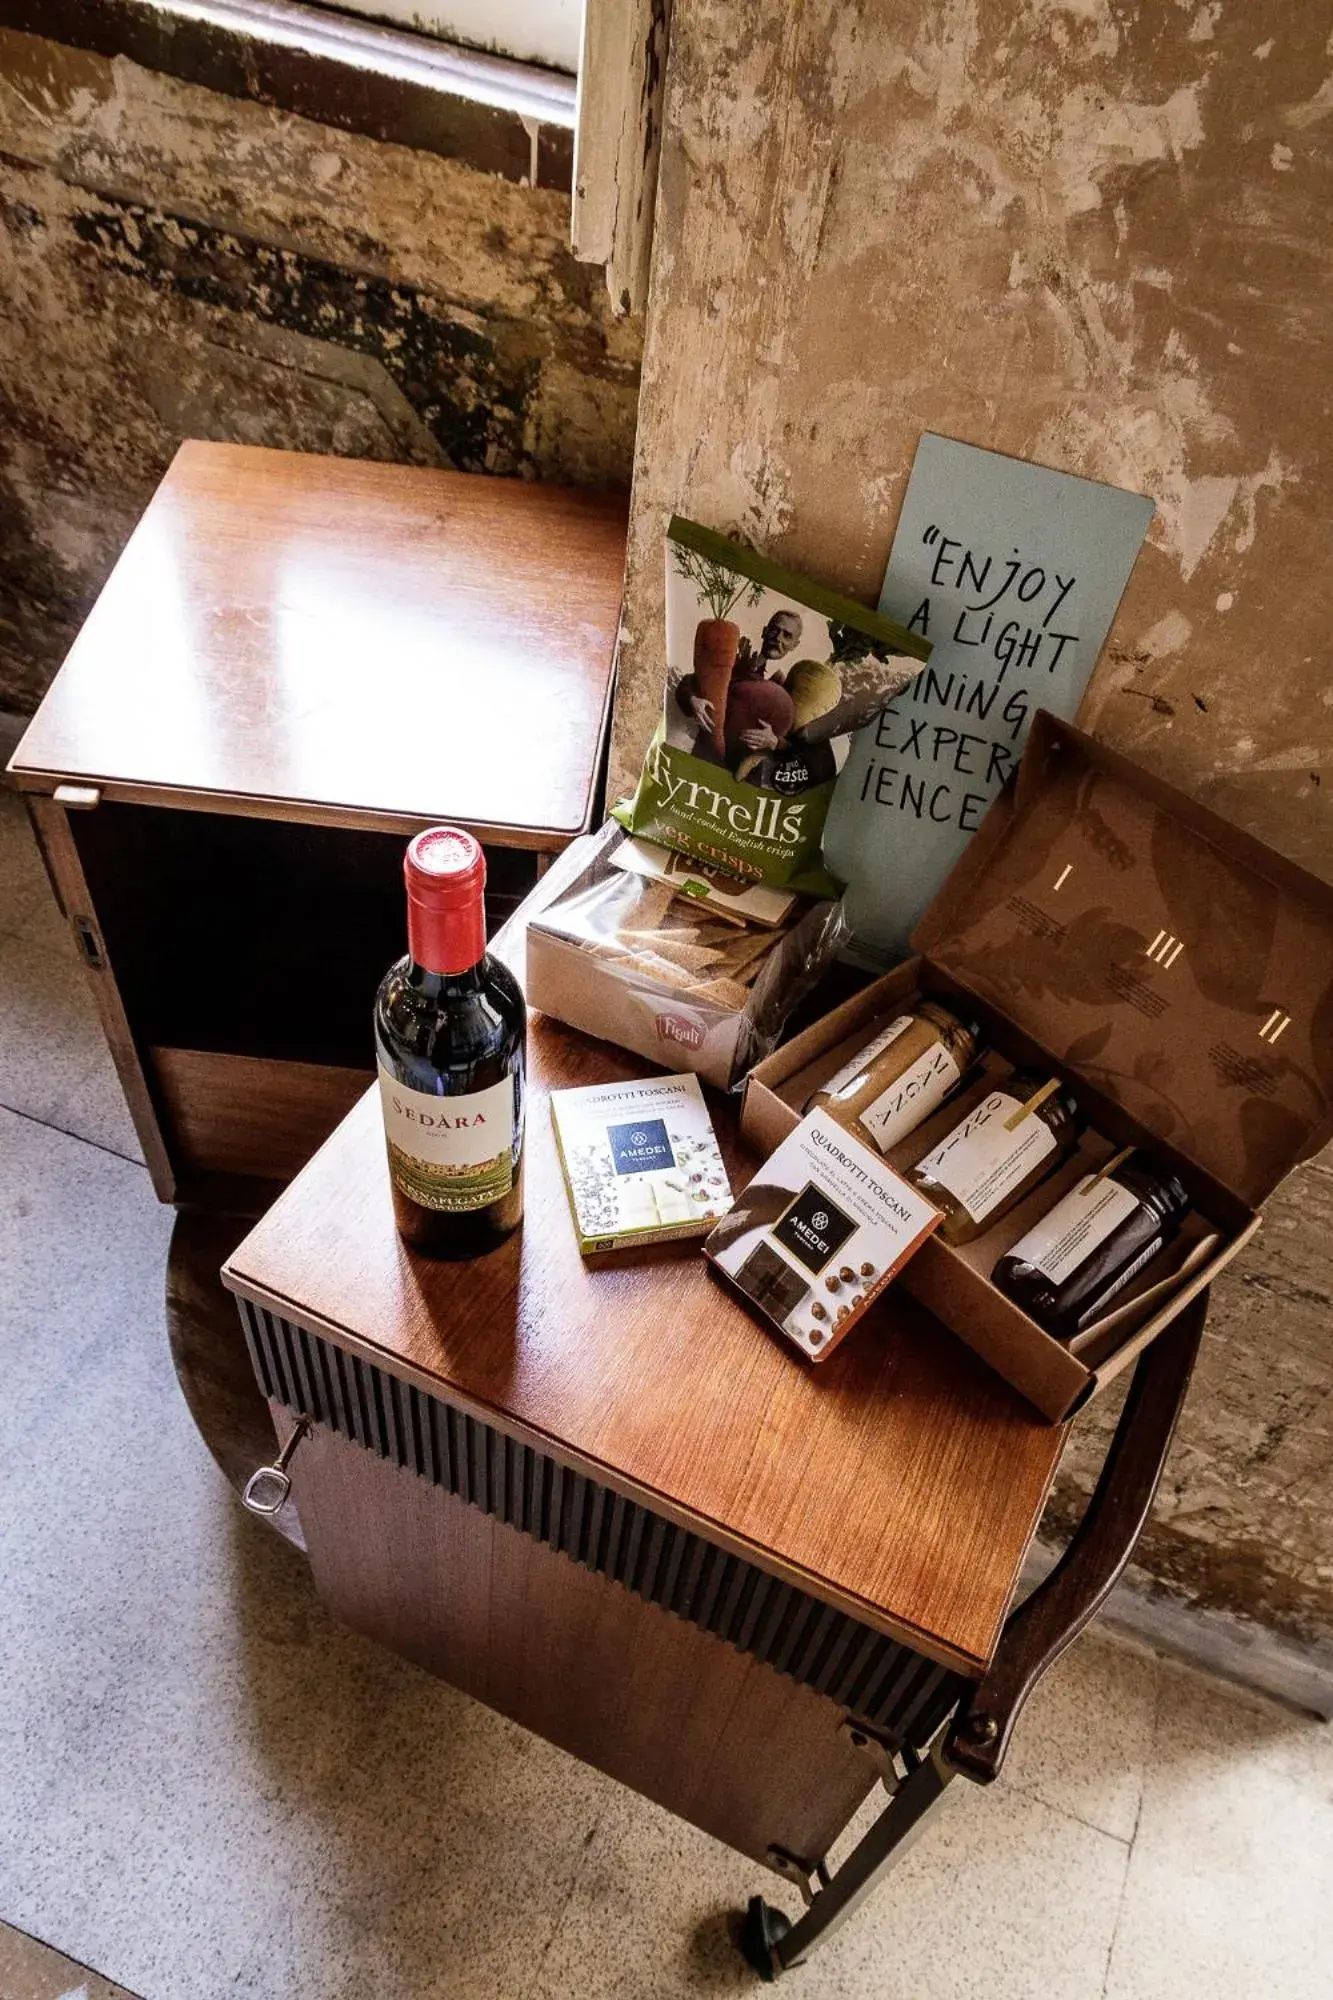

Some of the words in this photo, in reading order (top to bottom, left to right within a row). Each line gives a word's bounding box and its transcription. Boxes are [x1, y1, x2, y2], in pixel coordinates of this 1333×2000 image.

[906, 597, 930, 636] A
[645, 745, 803, 845] Tyrrells
[775, 768, 809, 783] taste
[653, 817, 691, 849] veg
[696, 842, 765, 880] crisps
[727, 830, 765, 852] English
[766, 844, 796, 860] crisps
[638, 1084, 687, 1100] TOSCANI
[618, 1145, 667, 1159] AMEDEI
[810, 1128, 869, 1184] QUADROTTI
[867, 1179, 913, 1223] TOSCANI
[789, 1215, 831, 1255] AMEDEI
